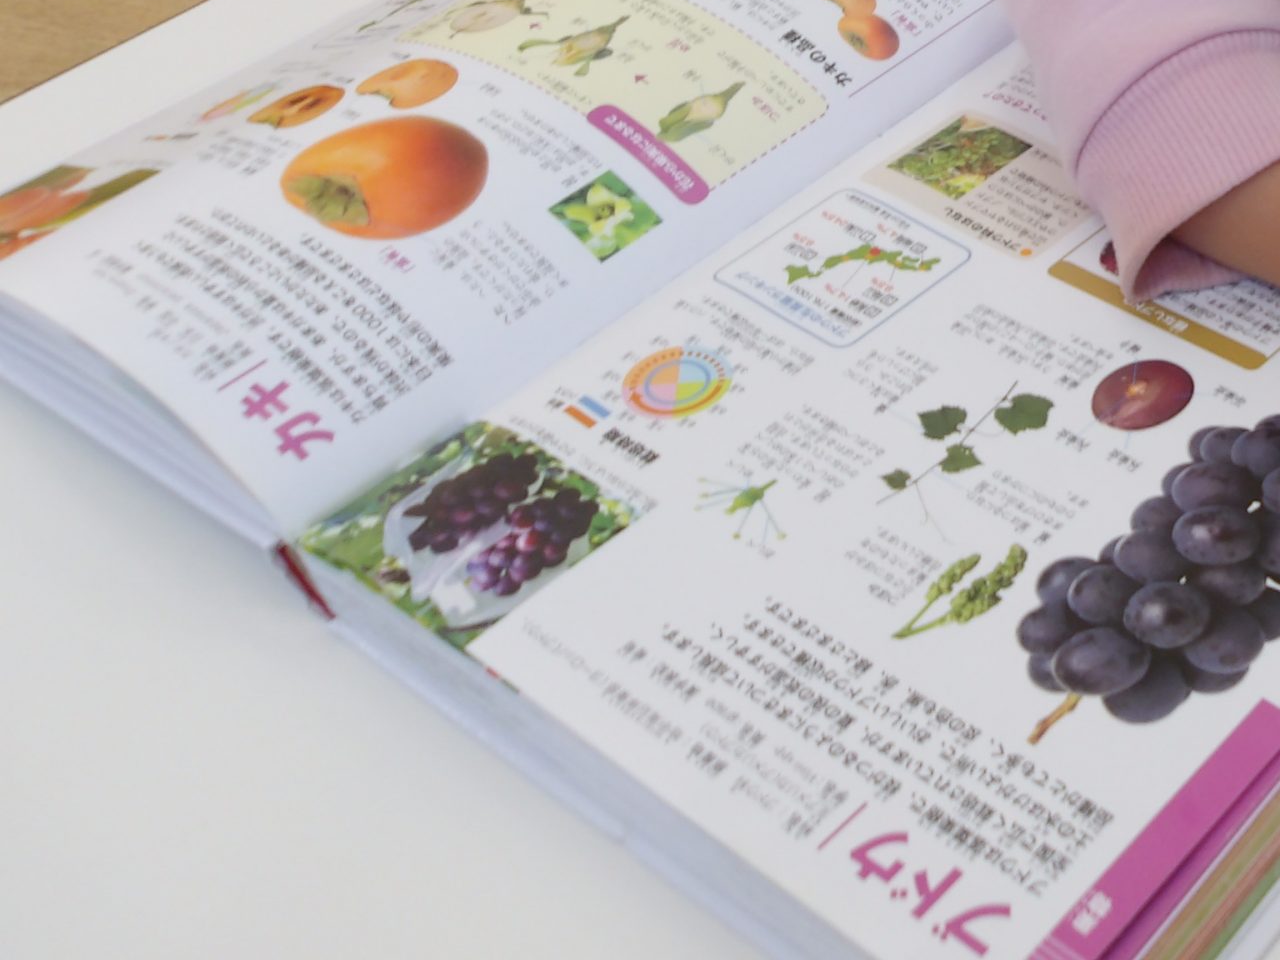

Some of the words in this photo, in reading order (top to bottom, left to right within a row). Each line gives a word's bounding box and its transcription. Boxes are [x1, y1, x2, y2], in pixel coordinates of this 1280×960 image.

[780, 26, 853, 90] カキの品種
[245, 384, 333, 459] カキ
[852, 833, 1011, 955] ブドウ
